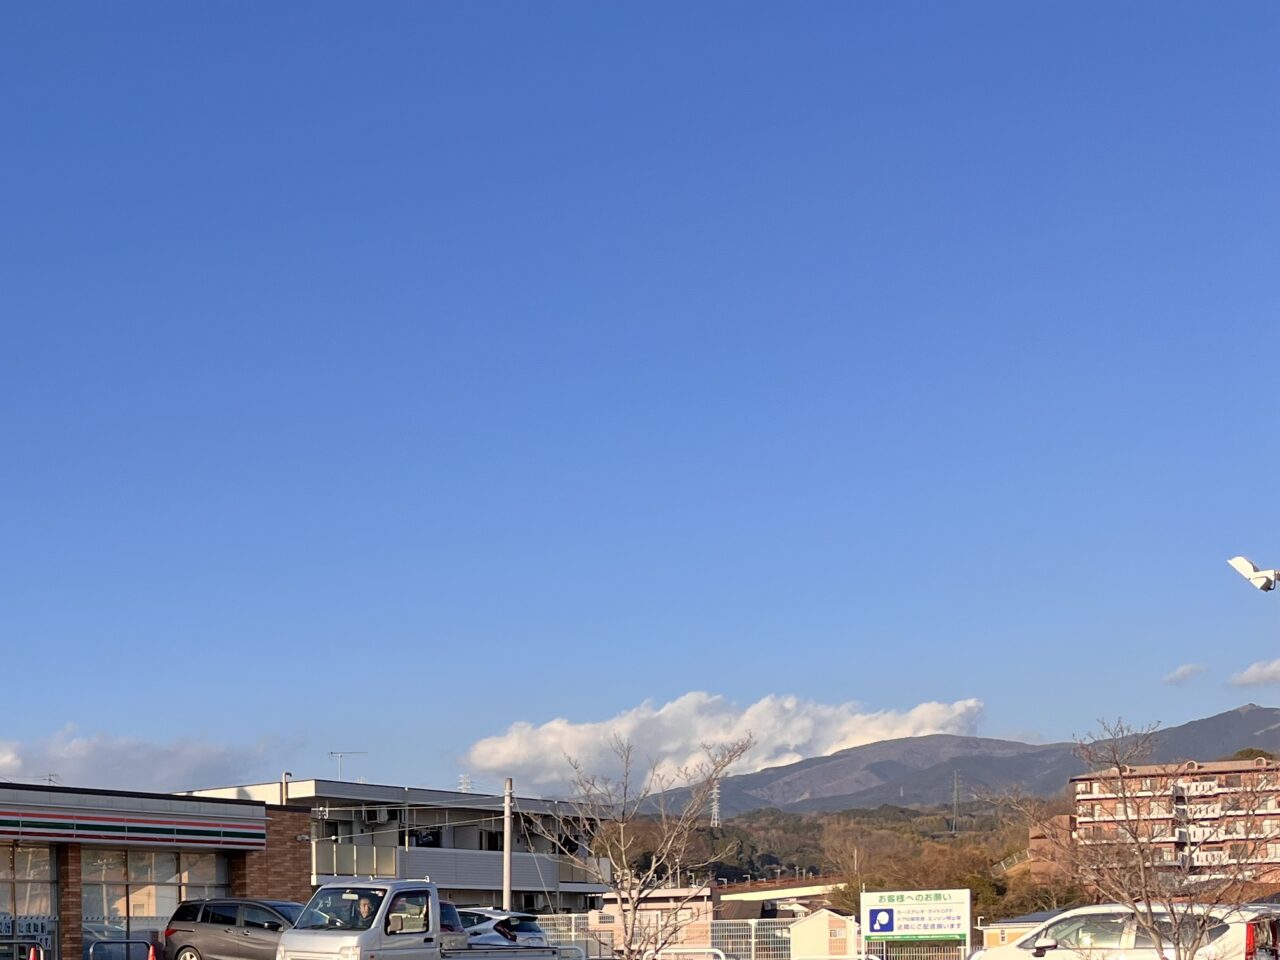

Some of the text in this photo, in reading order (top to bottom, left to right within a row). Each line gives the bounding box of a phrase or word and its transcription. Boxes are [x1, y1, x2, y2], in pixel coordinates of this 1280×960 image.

[878, 893, 952, 903] お客様へのお願い
